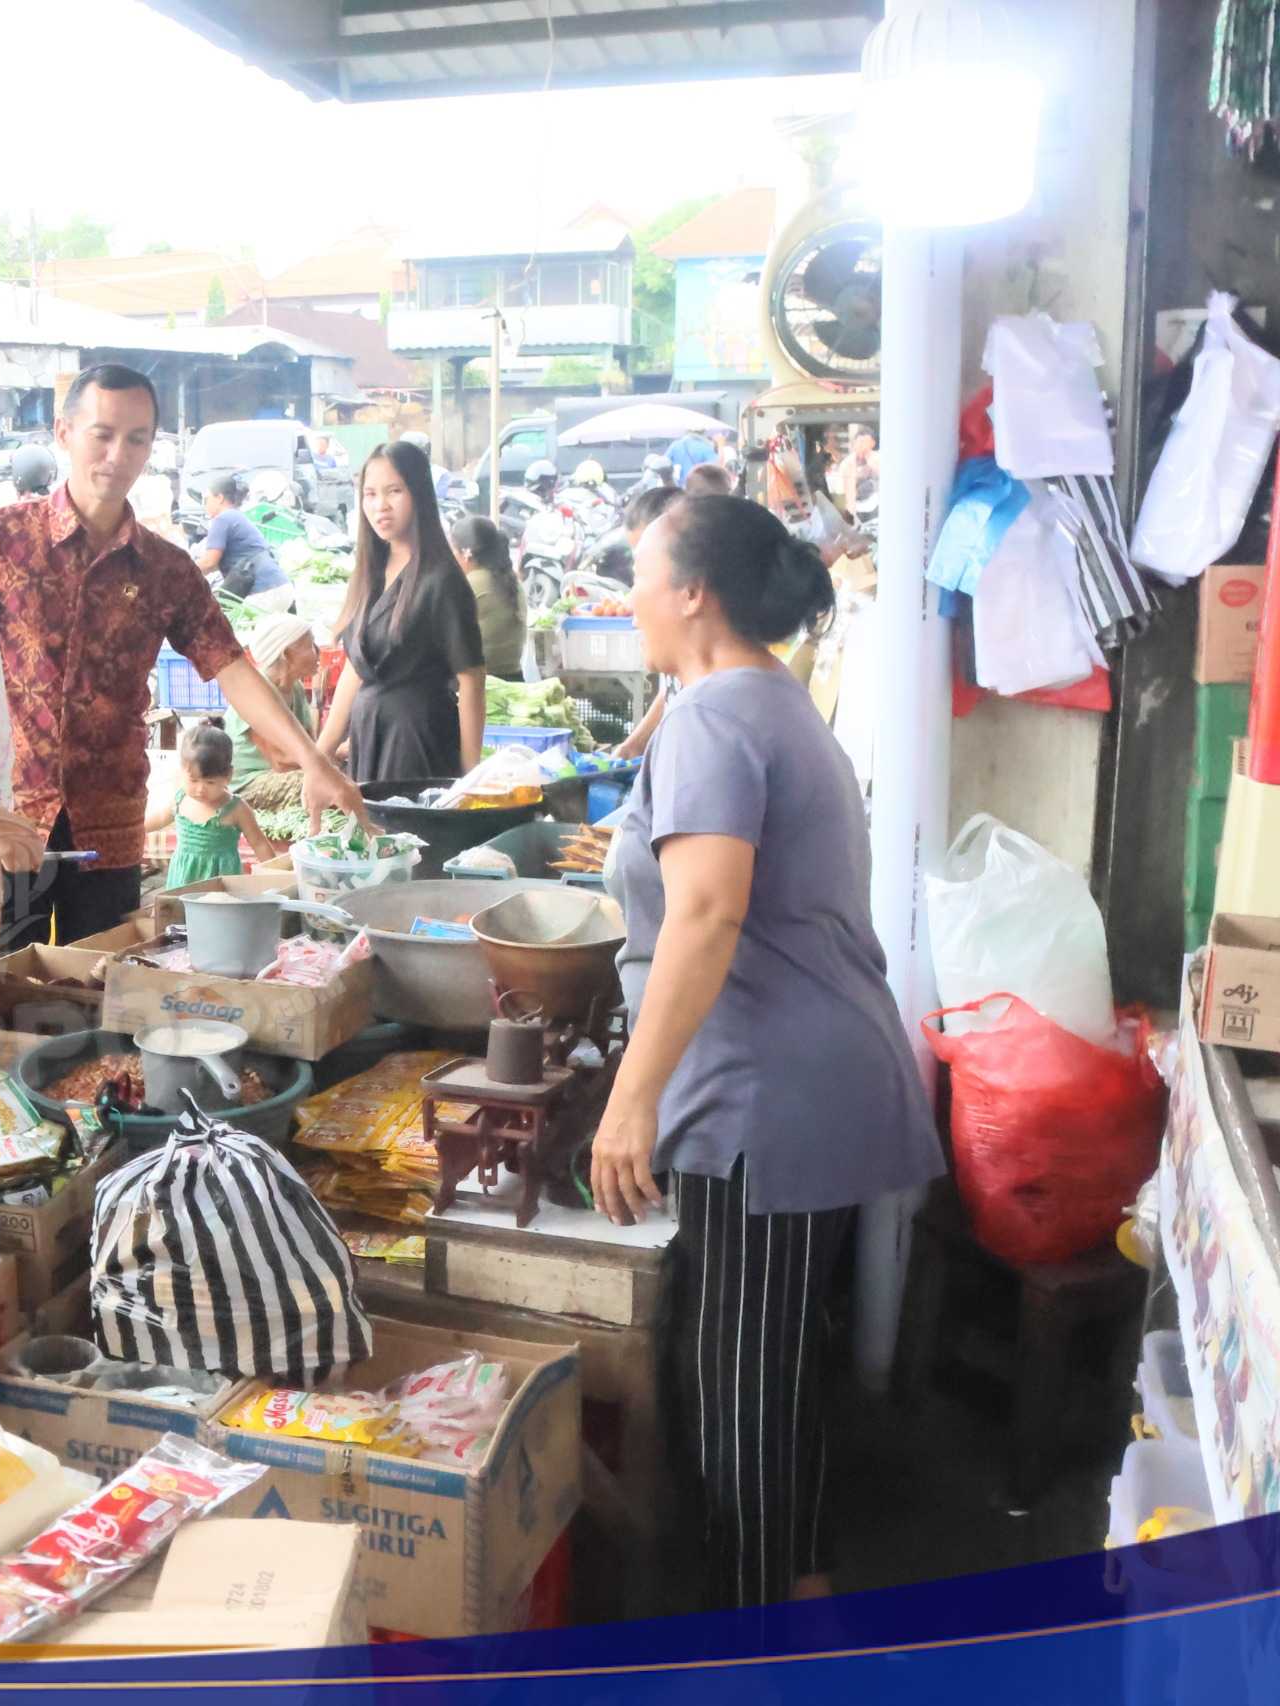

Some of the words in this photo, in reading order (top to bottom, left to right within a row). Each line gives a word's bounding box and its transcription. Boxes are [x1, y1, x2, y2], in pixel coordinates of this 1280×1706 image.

[160, 994, 244, 1022] Sedaap
[283, 1027, 295, 1040] 7
[66, 1439, 142, 1467] SEGIT
[321, 1497, 448, 1540] SEGITIGA
